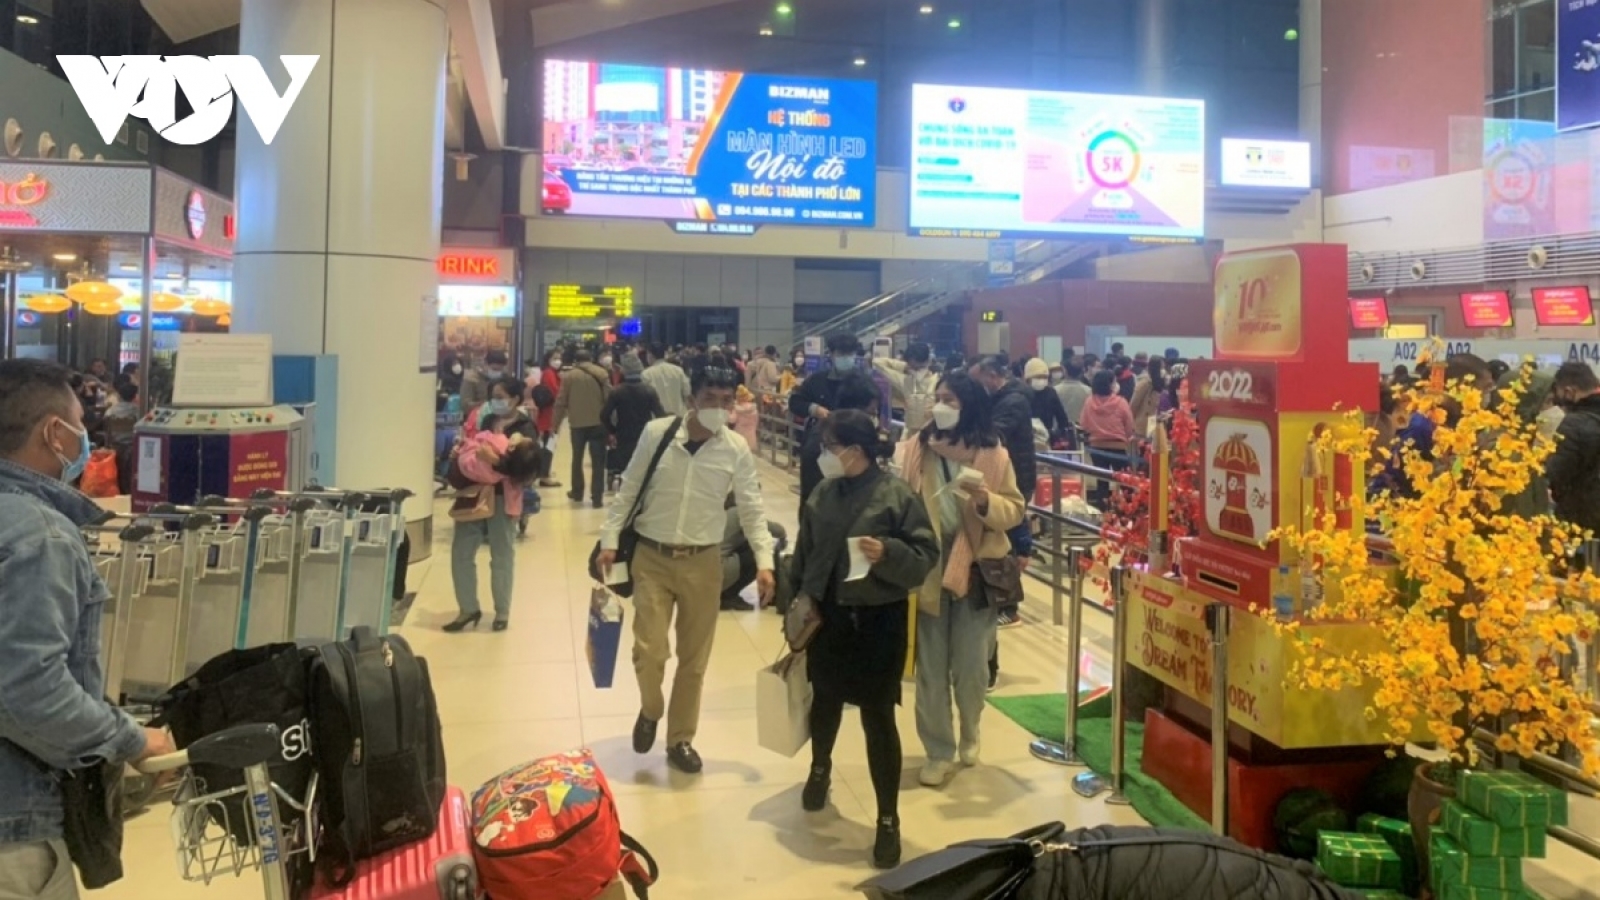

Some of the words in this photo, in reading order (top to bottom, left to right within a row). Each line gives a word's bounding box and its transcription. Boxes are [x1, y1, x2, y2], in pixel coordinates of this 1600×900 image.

[769, 85, 829, 100] BIZMAN
[768, 108, 785, 127] HỆ
[788, 109, 831, 127] THỐNG
[727, 127, 773, 152] MÀN
[777, 130, 825, 156] HÌNH
[829, 136, 866, 159] LED
[1102, 156, 1123, 172] 5K
[731, 182, 749, 198] TẠI
[751, 182, 774, 197] CÁC
[776, 183, 813, 199] THÀNH
[815, 184, 839, 200] PHỐ
[839, 186, 861, 200] LỚN
[1394, 341, 1417, 360] A02
[1208, 369, 1253, 400] 2022
[1143, 605, 1190, 647] WELCOME
[1141, 632, 1187, 681] DREAM
